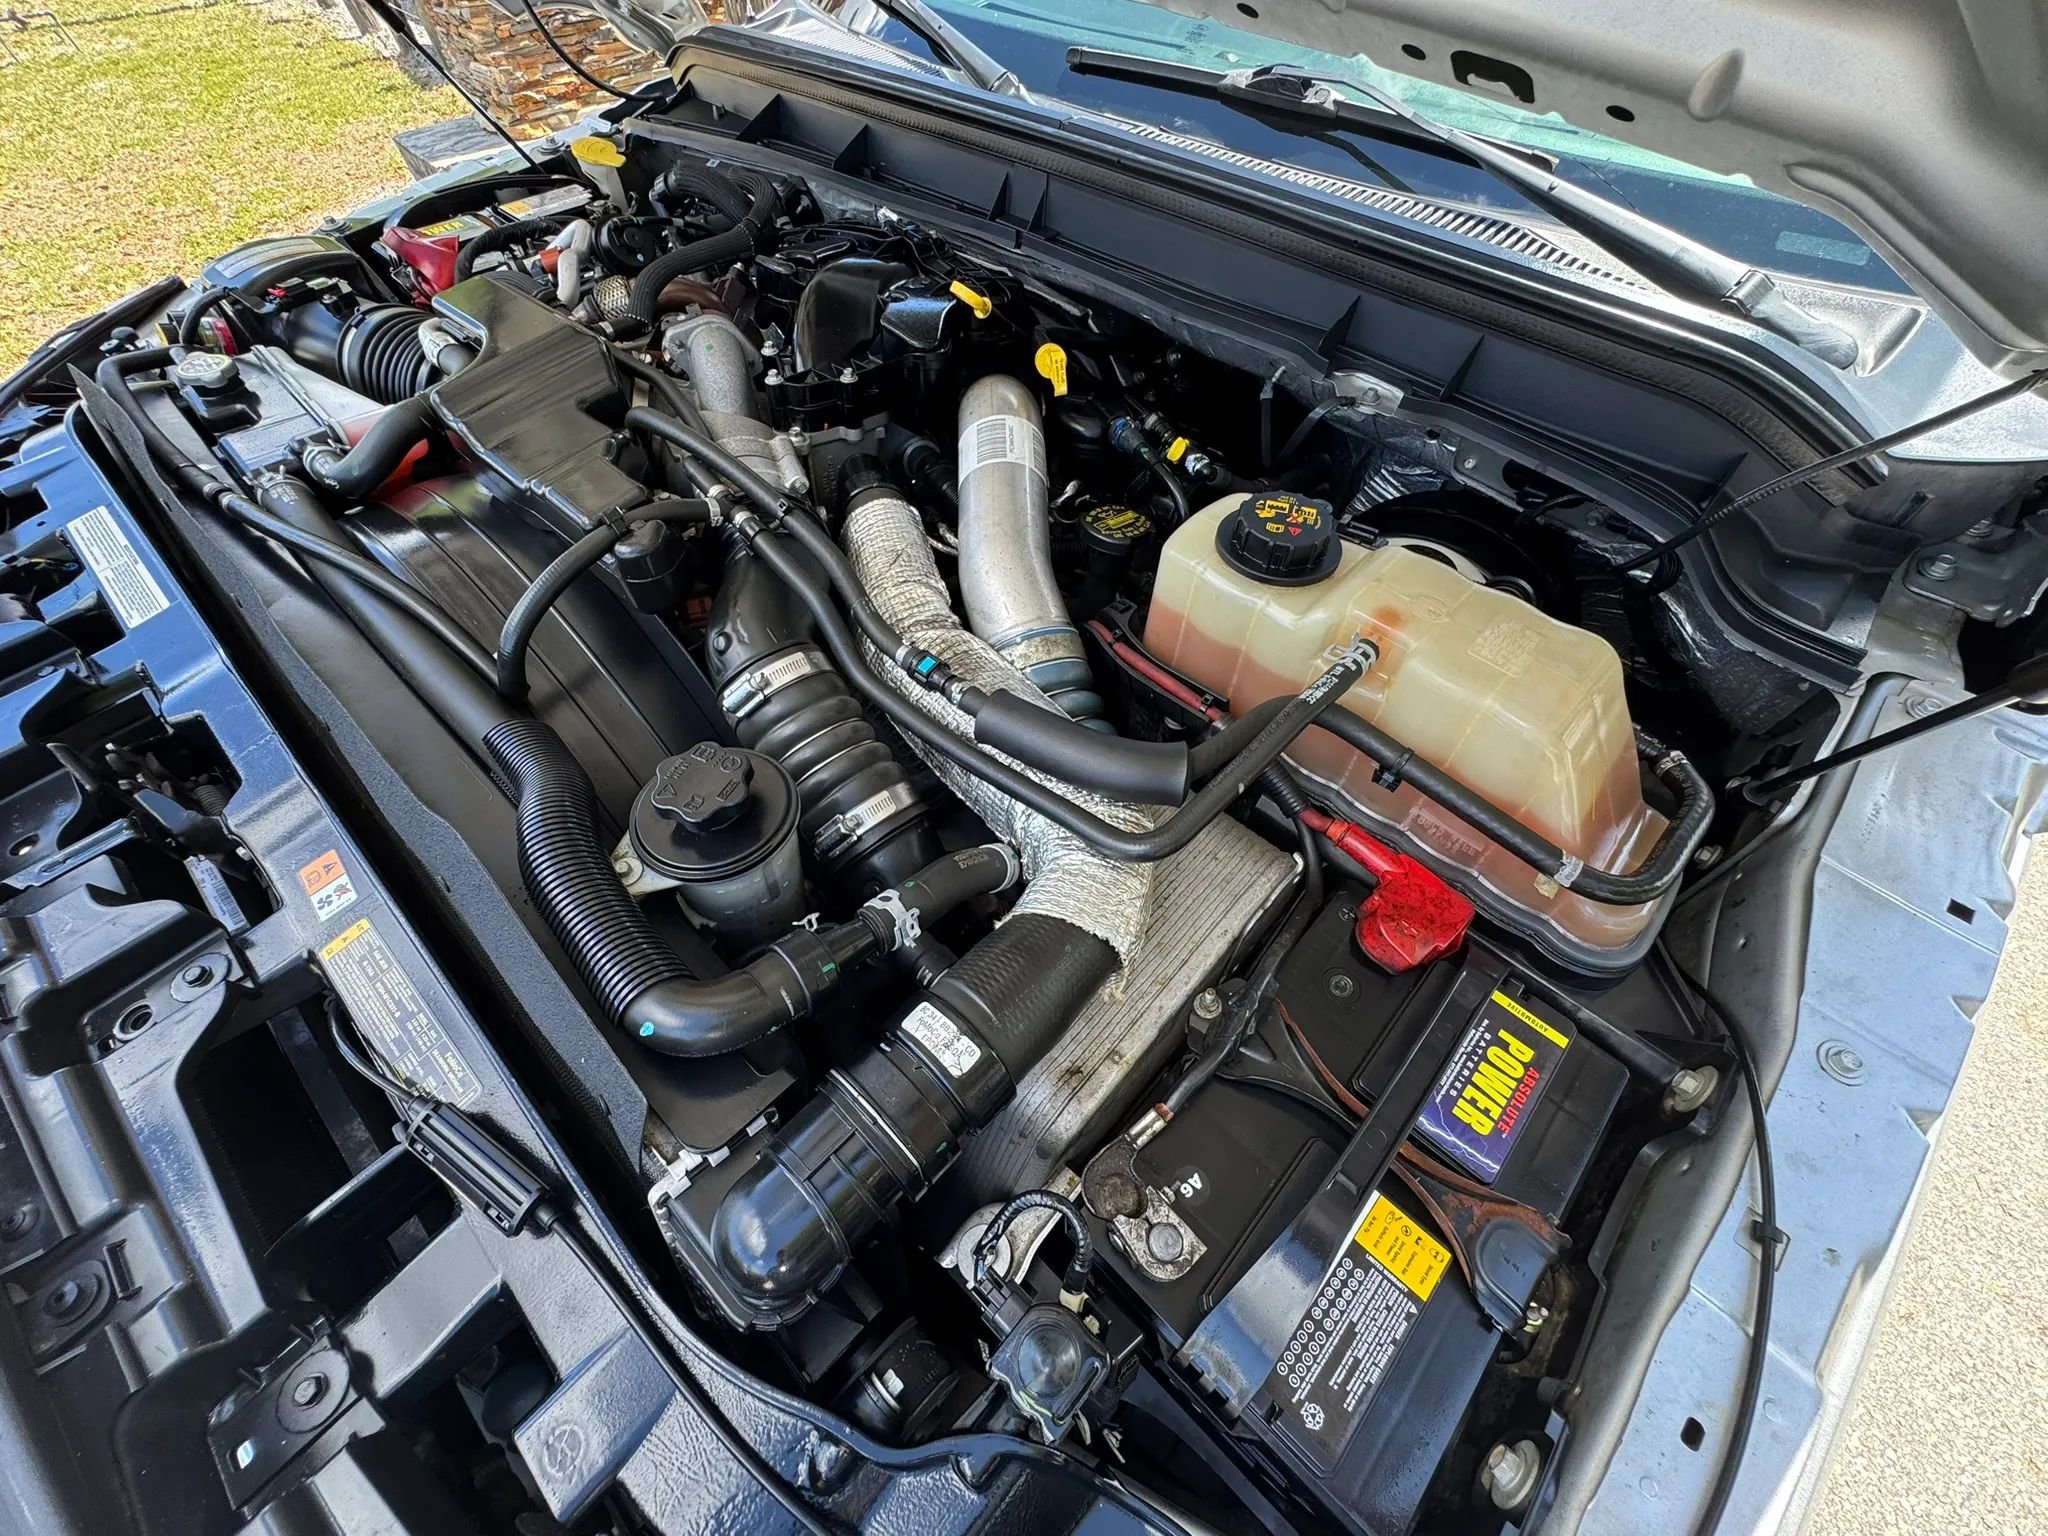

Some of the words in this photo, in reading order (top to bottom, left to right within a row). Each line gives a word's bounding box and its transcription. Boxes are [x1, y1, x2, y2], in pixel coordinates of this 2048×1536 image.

[1505, 999, 1549, 1033] AUTOMOTIVE
[442, 1050, 465, 1079] FoMoCo
[1447, 1030, 1492, 1099] BATTERIES
[1449, 1027, 1536, 1139] POWER
[1179, 1171, 1202, 1198] A6
[1364, 1252, 1383, 1271] LIMITED
[1381, 1268, 1408, 1293] WARRANTY
[1386, 1287, 1399, 1307] POISON
[1374, 1307, 1388, 1328] CAUSES
[1392, 1318, 1408, 1340] DANGER
[1355, 1341, 1369, 1360] BURNS
[1376, 1342, 1395, 1369] EXPLOSIVE
[1367, 1365, 1382, 1384] GASES
